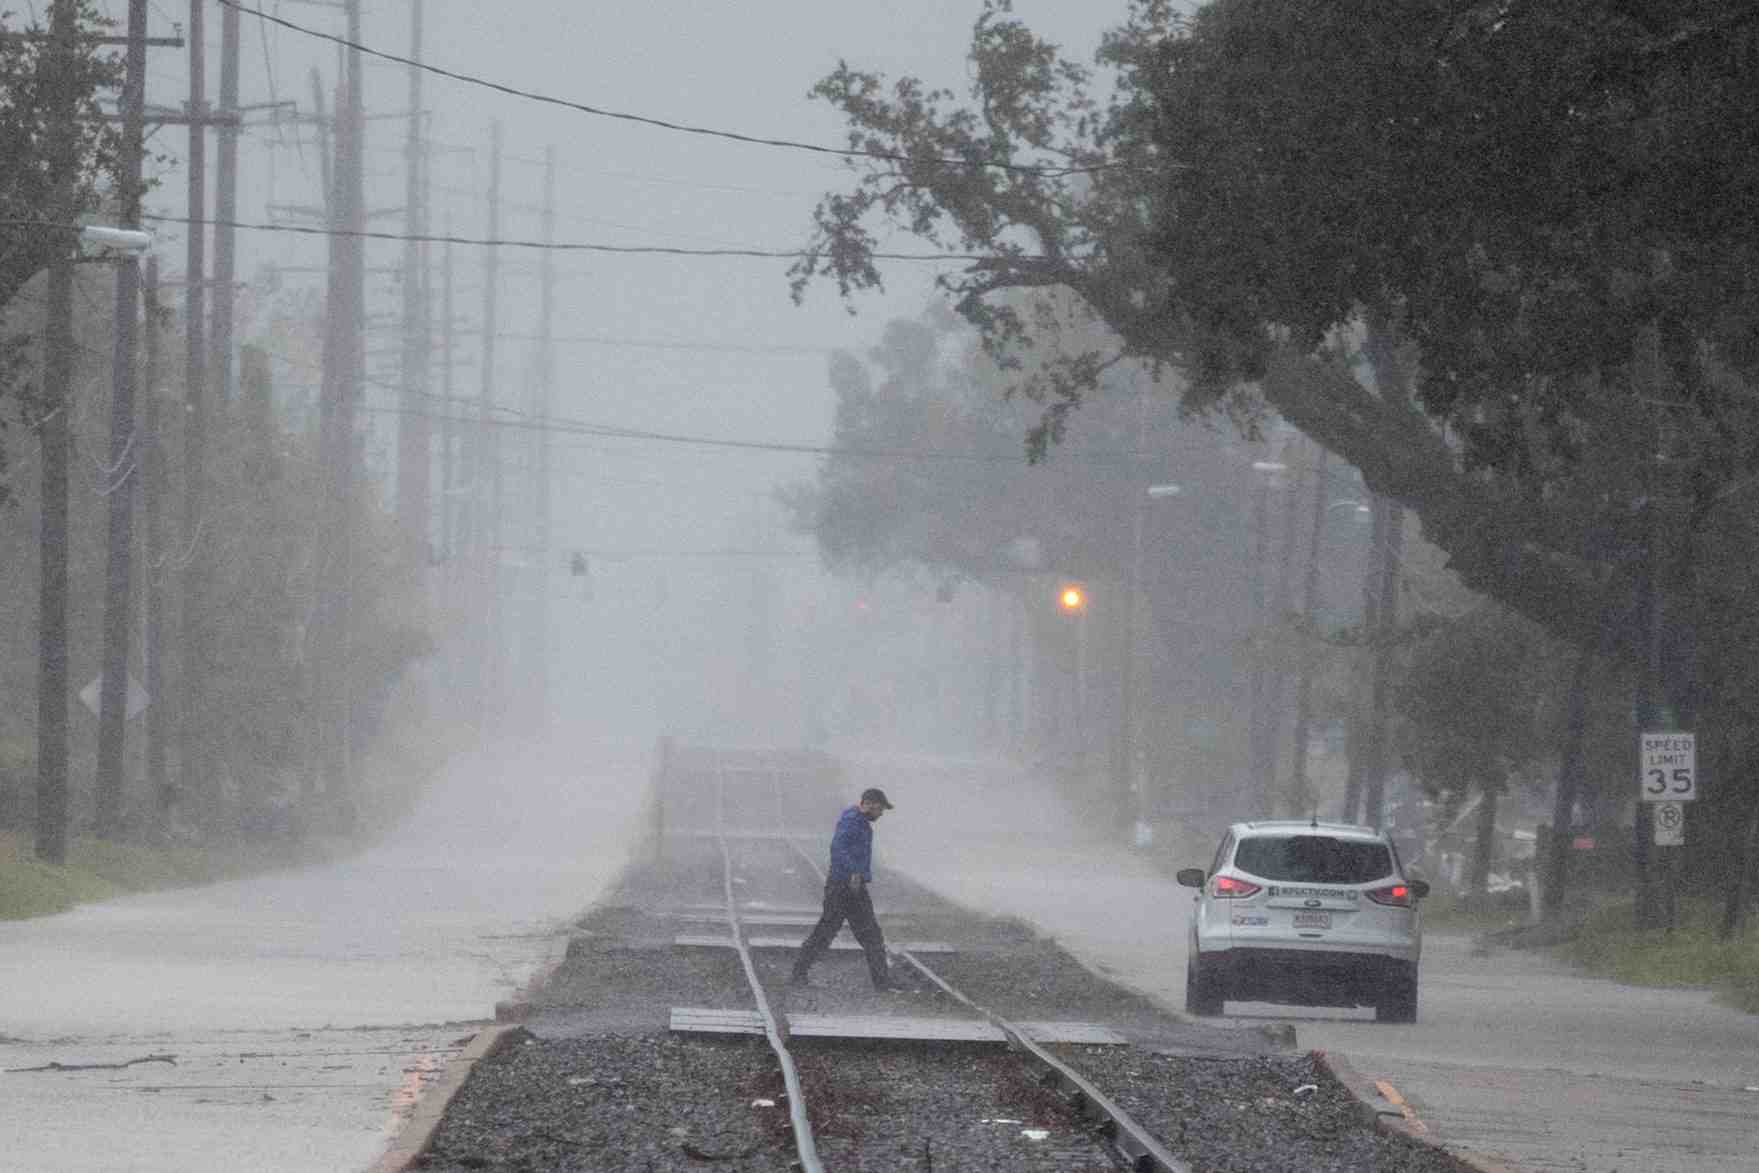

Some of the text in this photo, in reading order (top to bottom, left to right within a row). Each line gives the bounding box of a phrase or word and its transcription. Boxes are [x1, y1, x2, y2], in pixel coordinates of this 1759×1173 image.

[1646, 740, 1692, 751] SPEED
[1649, 755, 1687, 765] LIMIT
[1647, 768, 1692, 793] 35
